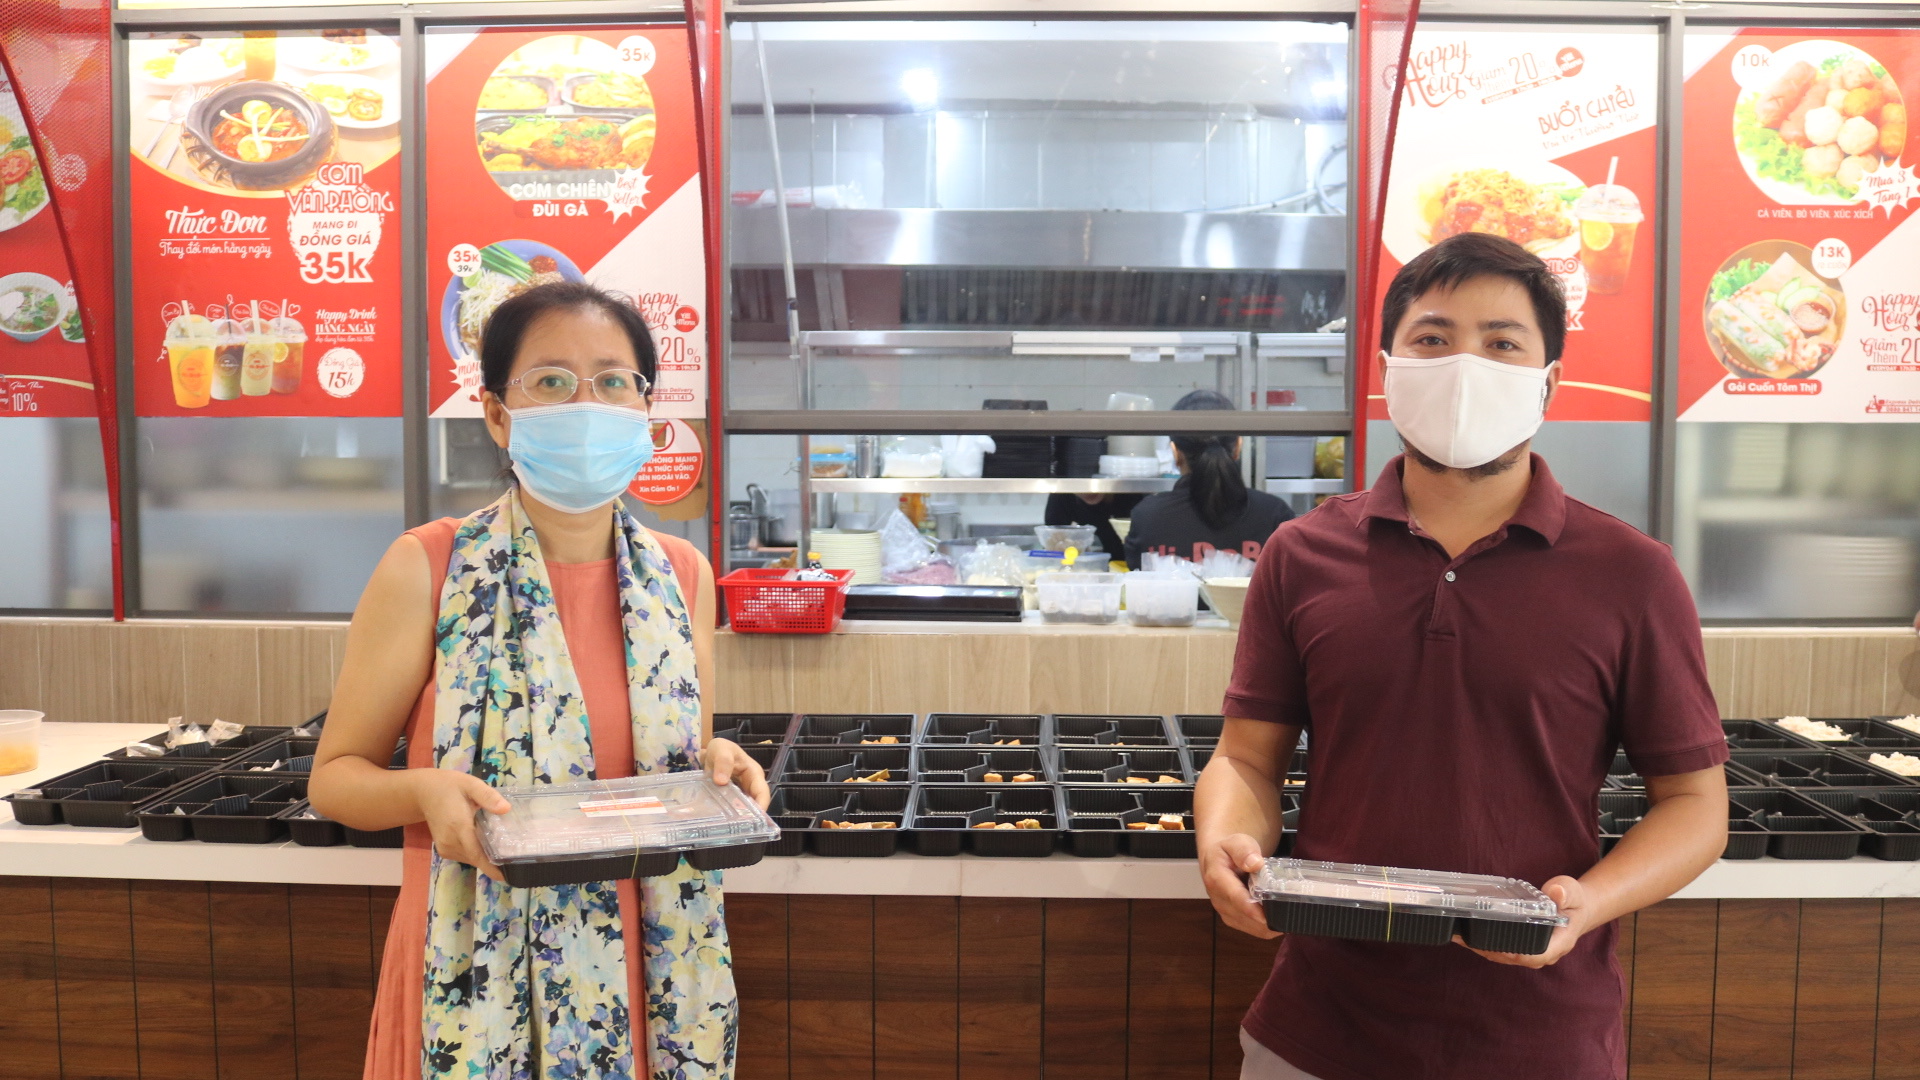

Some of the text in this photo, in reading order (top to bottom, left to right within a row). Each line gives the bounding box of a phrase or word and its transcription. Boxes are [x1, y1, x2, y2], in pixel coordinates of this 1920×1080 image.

[318, 163, 363, 185] CƠM
[1866, 170, 1906, 188] Mua 3
[509, 179, 611, 198] CƠM CHIÊN
[532, 200, 589, 217] ĐÙI GÀ
[165, 206, 267, 240] Thực Đơn
[312, 221, 358, 229] MANG ĐI
[300, 230, 372, 246] ĐỒNG GIÁ
[159, 241, 185, 259] Thay
[203, 243, 223, 254] món
[224, 241, 248, 259] hàng
[249, 243, 272, 259] ngày
[1819, 246, 1845, 257] 13K
[315, 307, 377, 324] Happy Drink
[660, 336, 700, 363] 20%
[1777, 381, 1798, 393] Tôm
[11, 393, 38, 412] 10%
